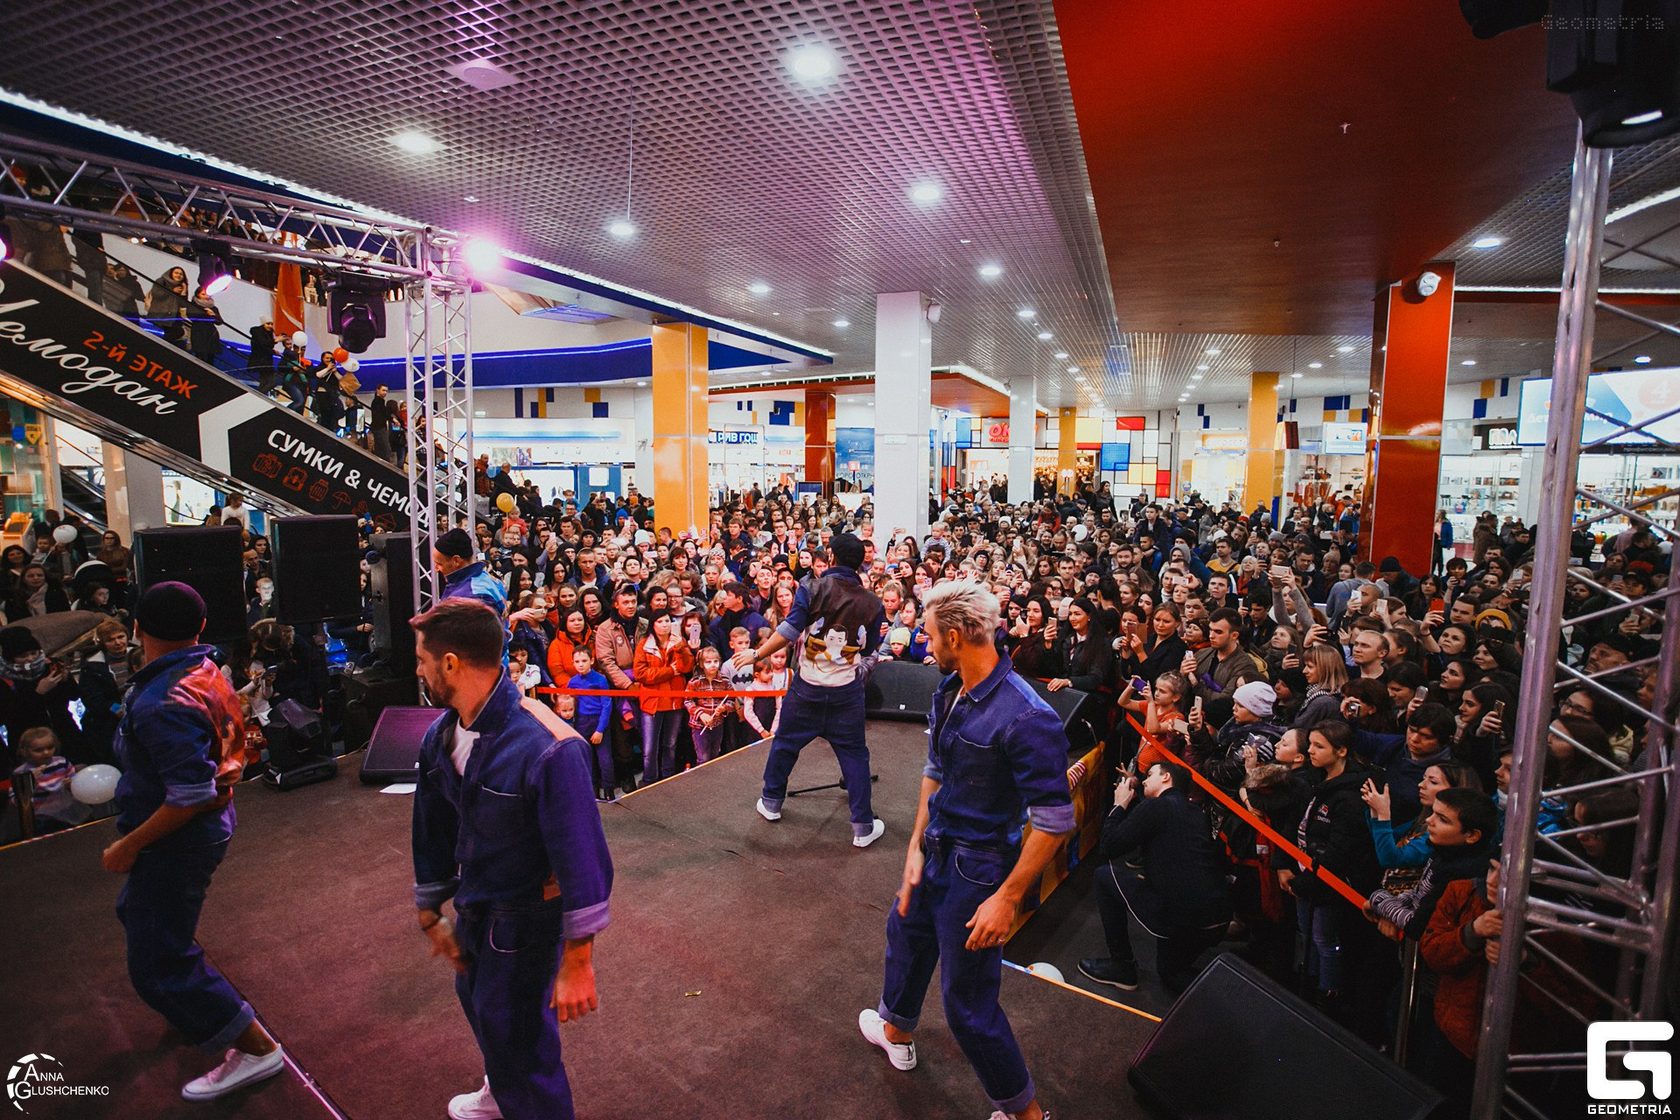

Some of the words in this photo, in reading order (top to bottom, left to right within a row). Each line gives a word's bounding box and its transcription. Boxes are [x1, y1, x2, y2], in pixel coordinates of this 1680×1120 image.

[128, 354, 199, 399] ЭТАЖ
[267, 429, 345, 479] СУМКИ
[344, 469, 362, 490] &
